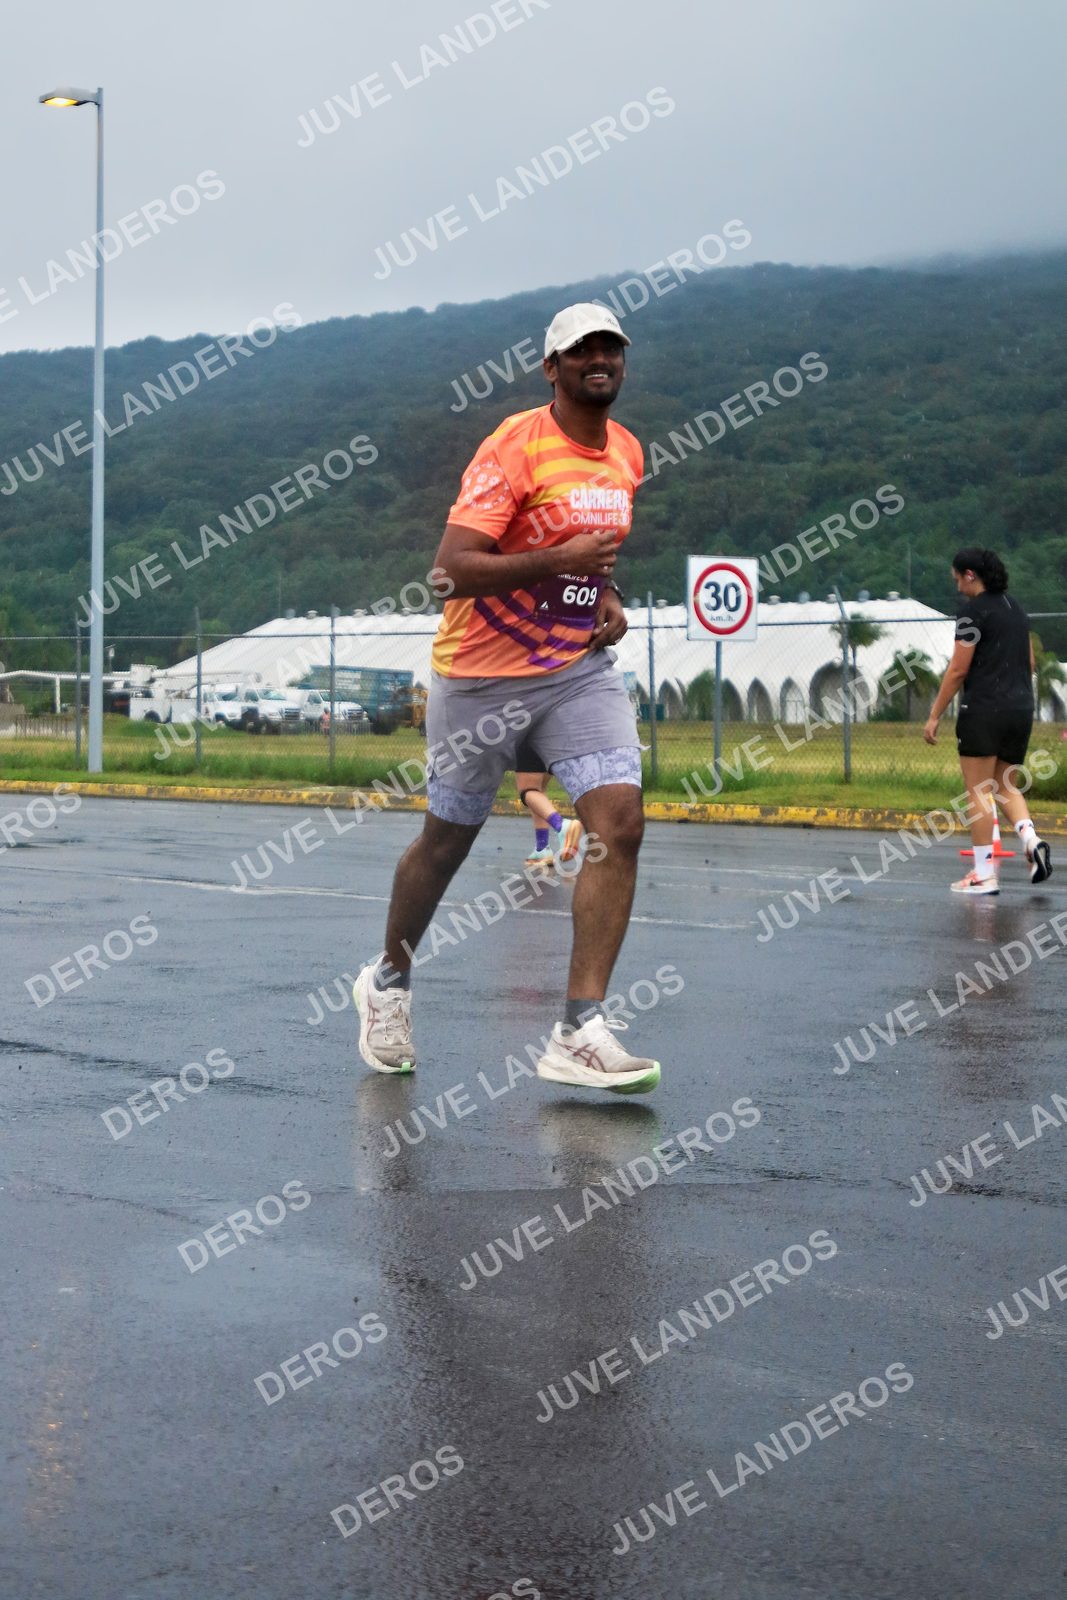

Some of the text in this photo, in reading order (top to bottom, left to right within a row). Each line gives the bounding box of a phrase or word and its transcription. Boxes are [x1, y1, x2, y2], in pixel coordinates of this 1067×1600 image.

[570, 487, 629, 510] CARRERA
[570, 511, 618, 525] OMNILIFE
[562, 585, 598, 606] 609
[704, 581, 742, 612] 30
